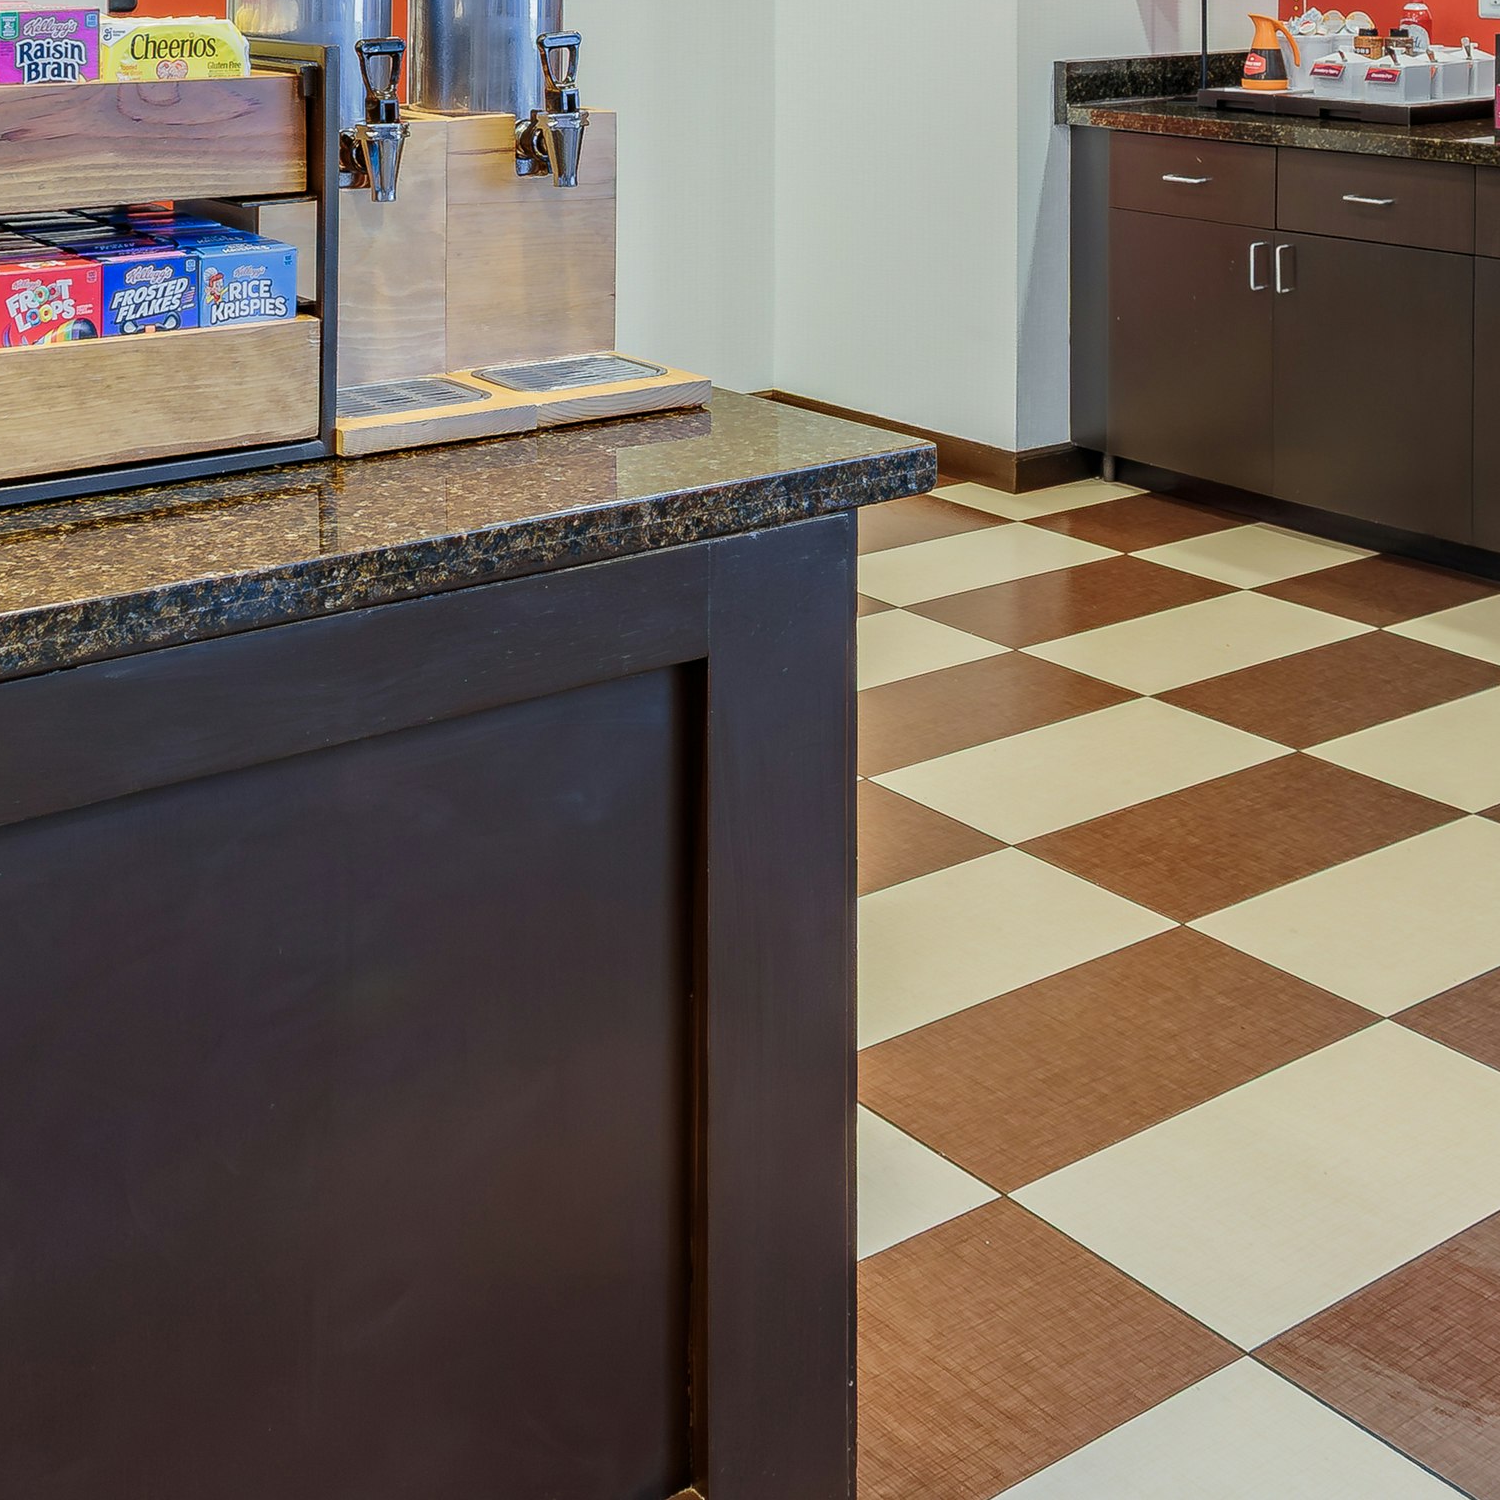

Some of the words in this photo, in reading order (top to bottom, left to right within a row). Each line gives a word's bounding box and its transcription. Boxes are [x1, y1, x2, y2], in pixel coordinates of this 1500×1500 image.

[24, 17, 78, 38] Kellogg's
[18, 41, 85, 66] Raisin
[130, 32, 216, 60] Cheerios
[26, 62, 77, 83] Bran
[207, 61, 228, 70] Gluten
[228, 61, 242, 69] Free
[125, 264, 174, 285] Kellogg's
[233, 265, 266, 278] Kellogg's
[5, 279, 73, 318] FROOT
[110, 278, 189, 310] FROSTED
[228, 279, 272, 301] RICE
[15, 299, 76, 333] LOOPS
[114, 294, 182, 324] FLAKES
[210, 296, 287, 325] KRISPIES
